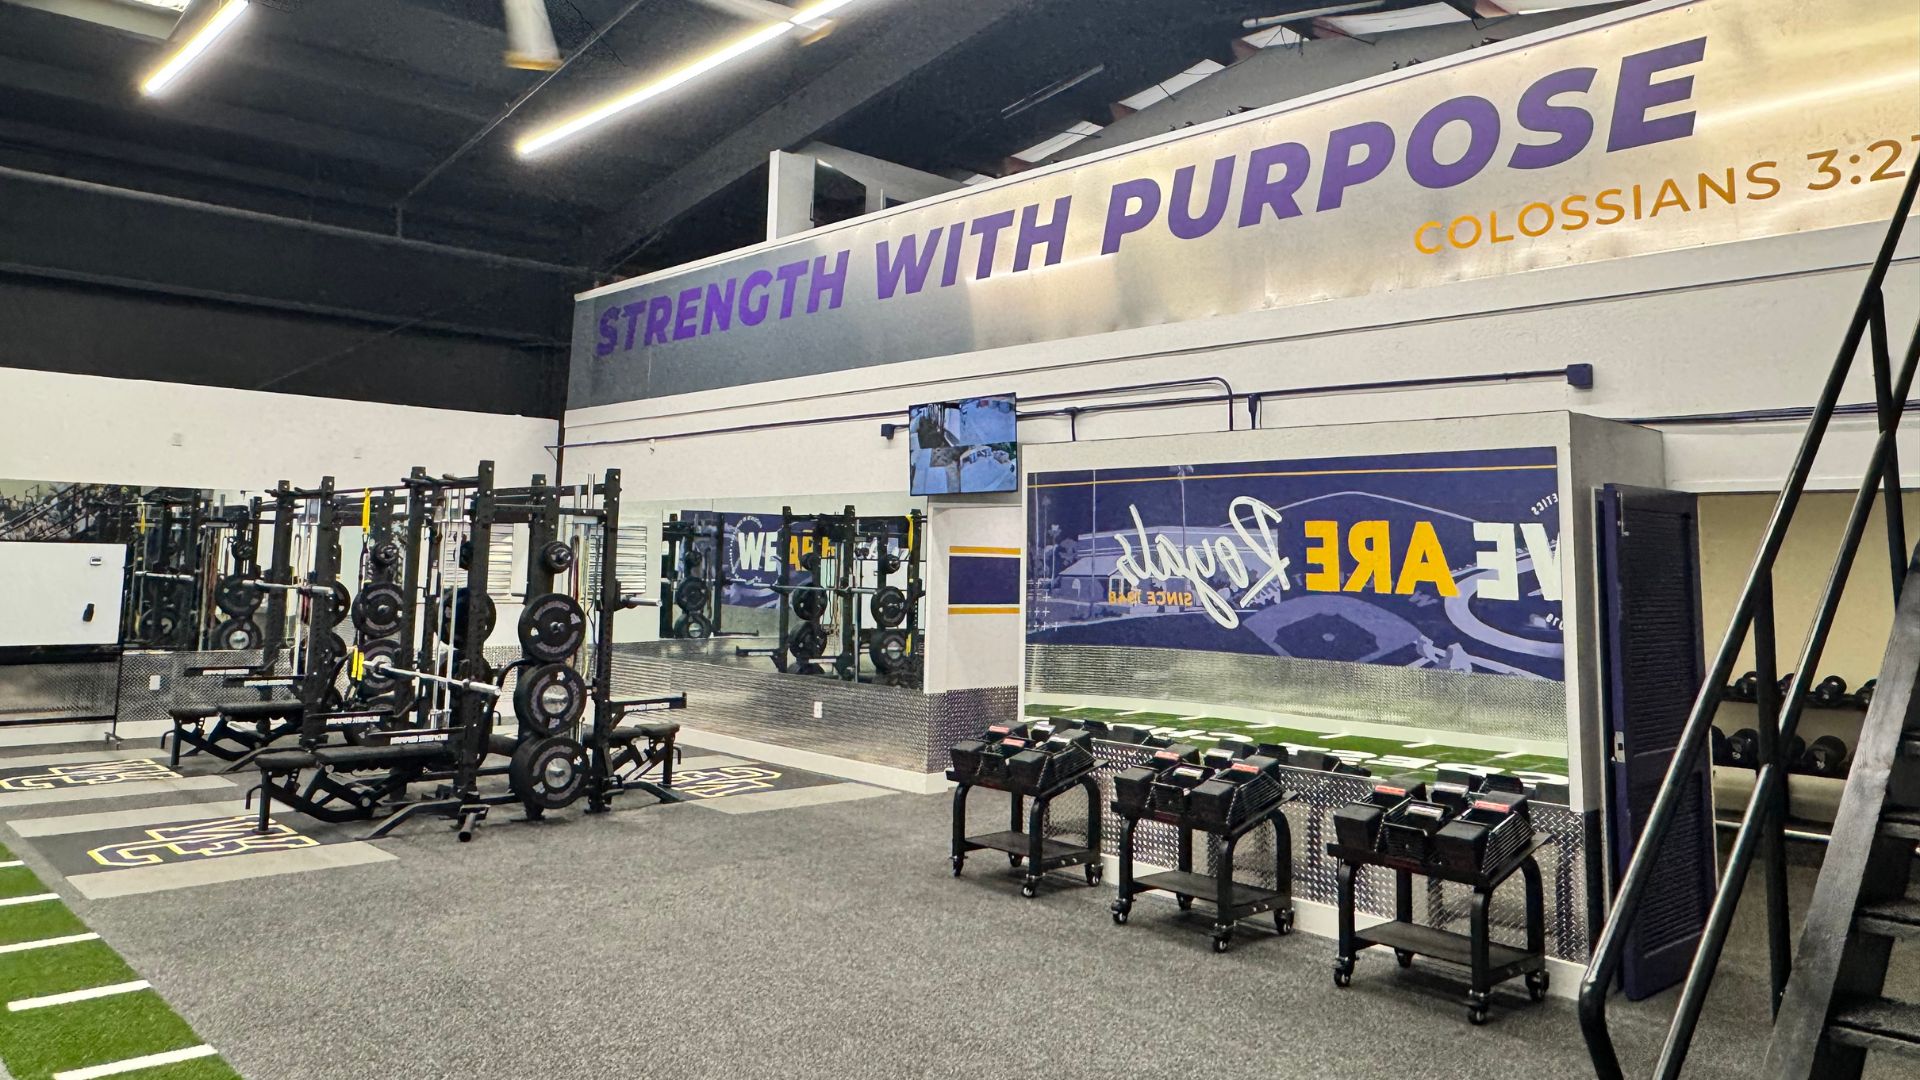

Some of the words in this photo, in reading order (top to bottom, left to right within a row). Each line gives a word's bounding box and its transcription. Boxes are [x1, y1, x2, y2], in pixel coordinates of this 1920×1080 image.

[596, 249, 850, 358] STRENGTH
[876, 198, 1068, 300] WITH
[1101, 36, 1707, 256] PURPOSE
[1414, 162, 1781, 255] COLOSSIANS
[1807, 135, 1920, 190] 3:2
[738, 531, 778, 572] WE
